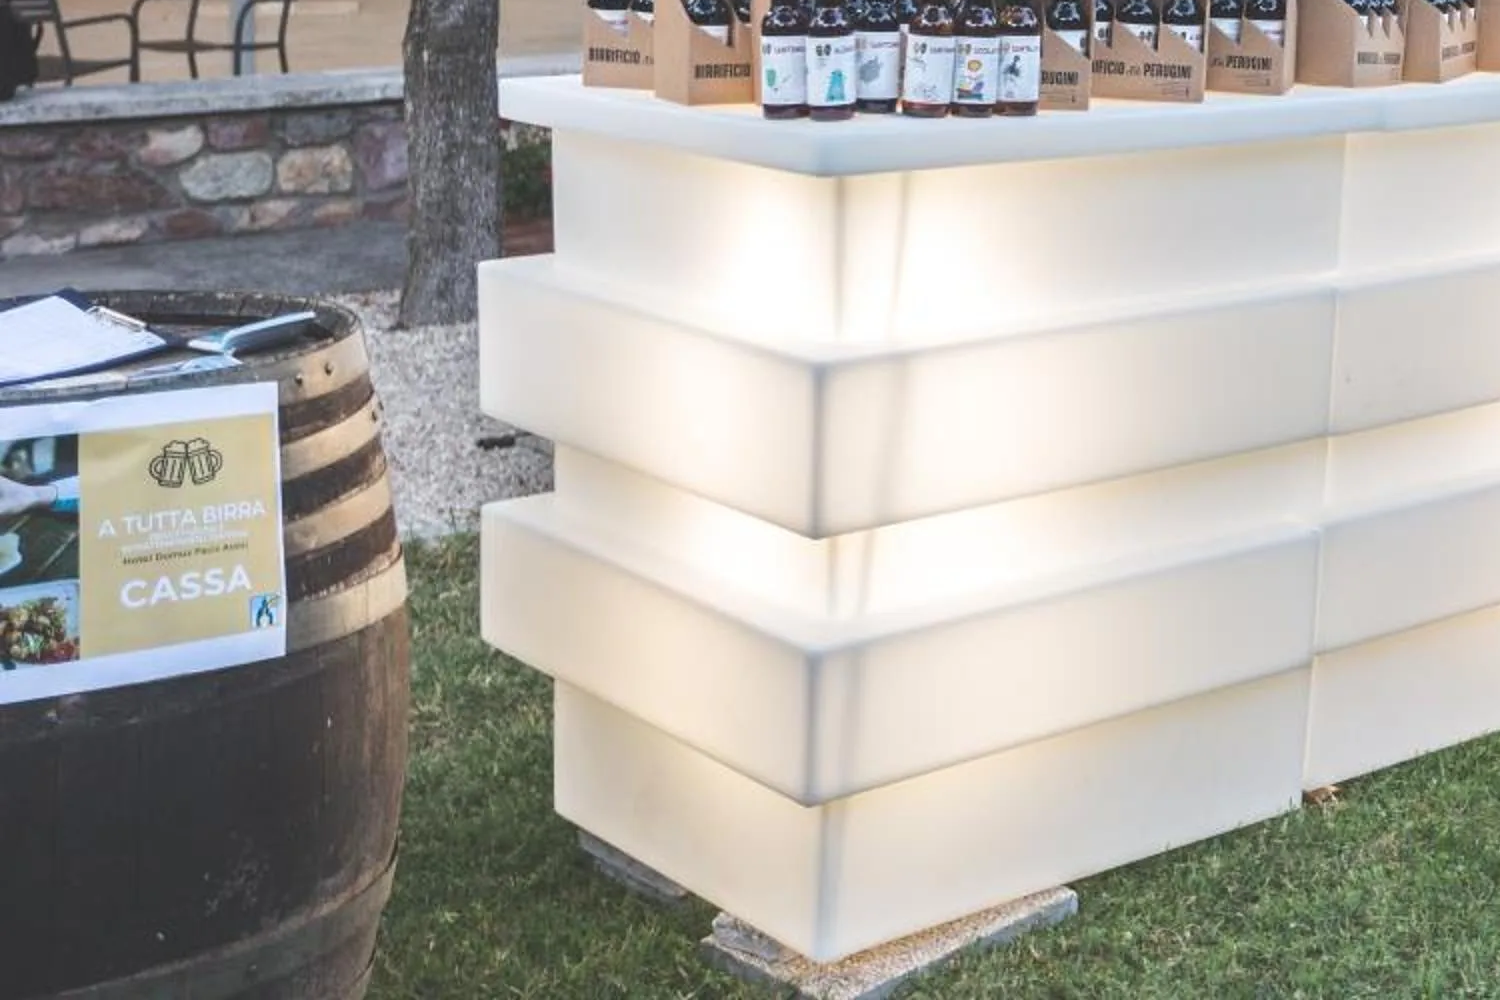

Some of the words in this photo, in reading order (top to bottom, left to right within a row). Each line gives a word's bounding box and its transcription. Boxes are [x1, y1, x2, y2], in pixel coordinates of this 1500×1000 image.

[1040, 70, 1079, 85] RUGINI
[1143, 62, 1192, 79] PERUGINI
[98, 519, 116, 539] A
[122, 508, 197, 535] TUTTA
[203, 501, 265, 524] BIRRA
[120, 564, 252, 608] CASSA
